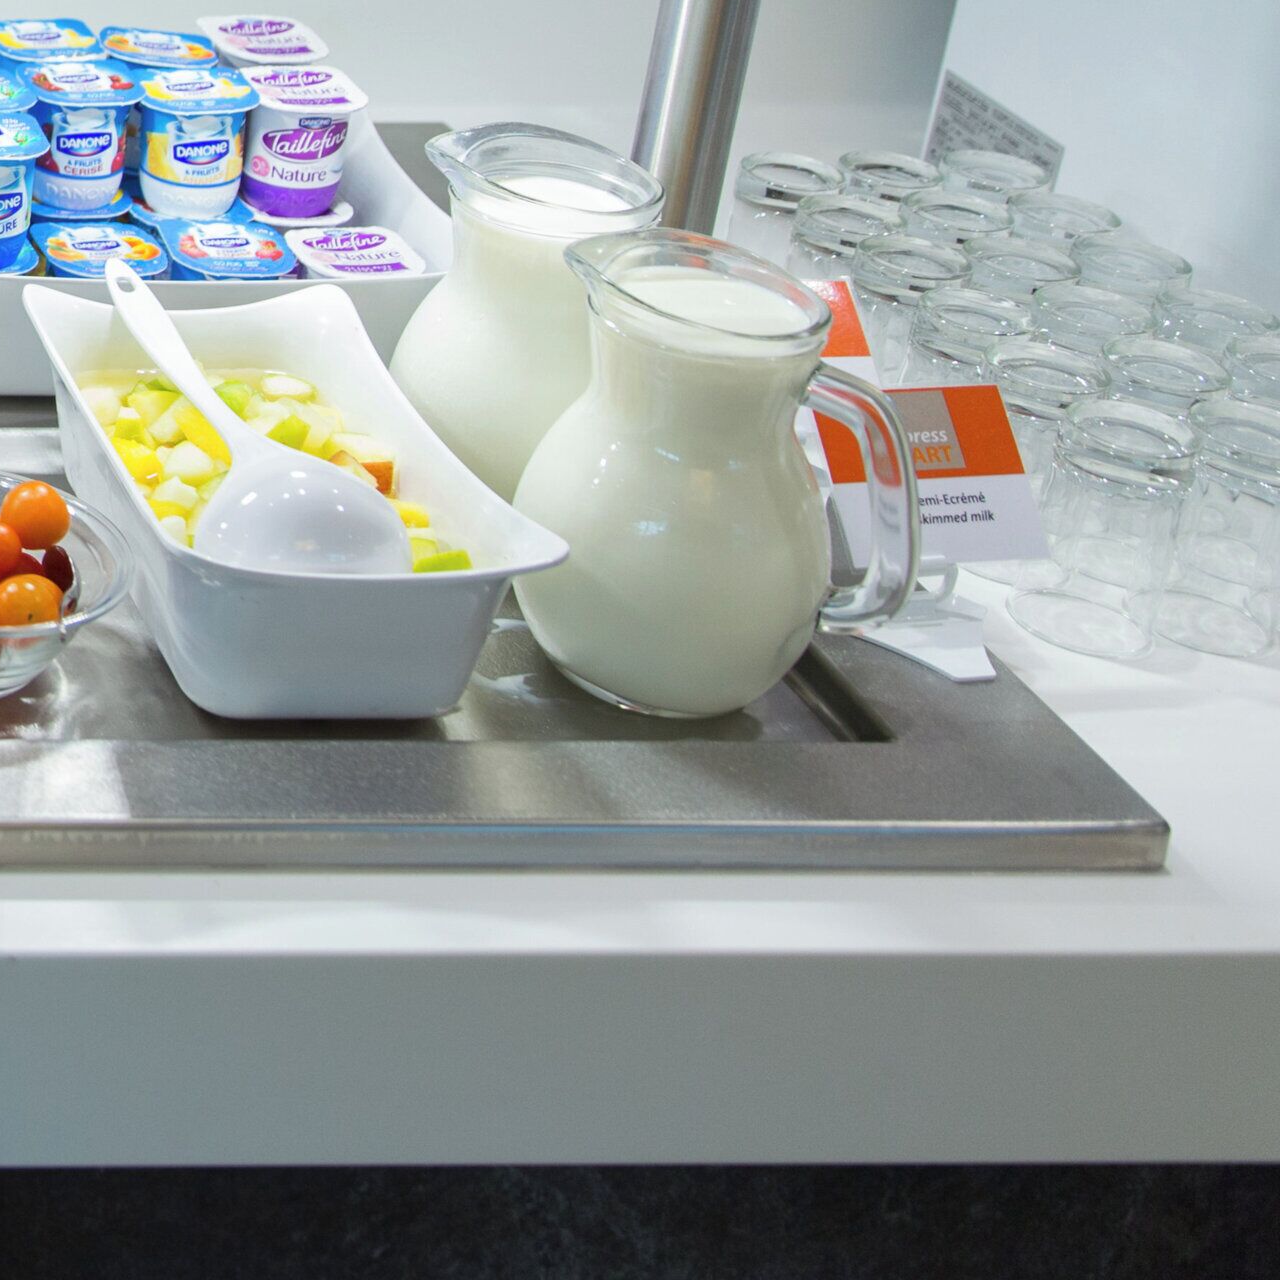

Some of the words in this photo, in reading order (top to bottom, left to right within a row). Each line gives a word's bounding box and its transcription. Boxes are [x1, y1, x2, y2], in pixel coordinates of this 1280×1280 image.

[59, 134, 111, 149] DANONE
[176, 142, 228, 158] DANONE
[63, 165, 104, 176] CERISE
[271, 166, 327, 182] Nature
[306, 232, 384, 251] Taillefine
[907, 430, 949, 444] ress
[912, 445, 953, 464] ART
[919, 491, 986, 507] emi-Ecrémé
[970, 510, 995, 522] milk
